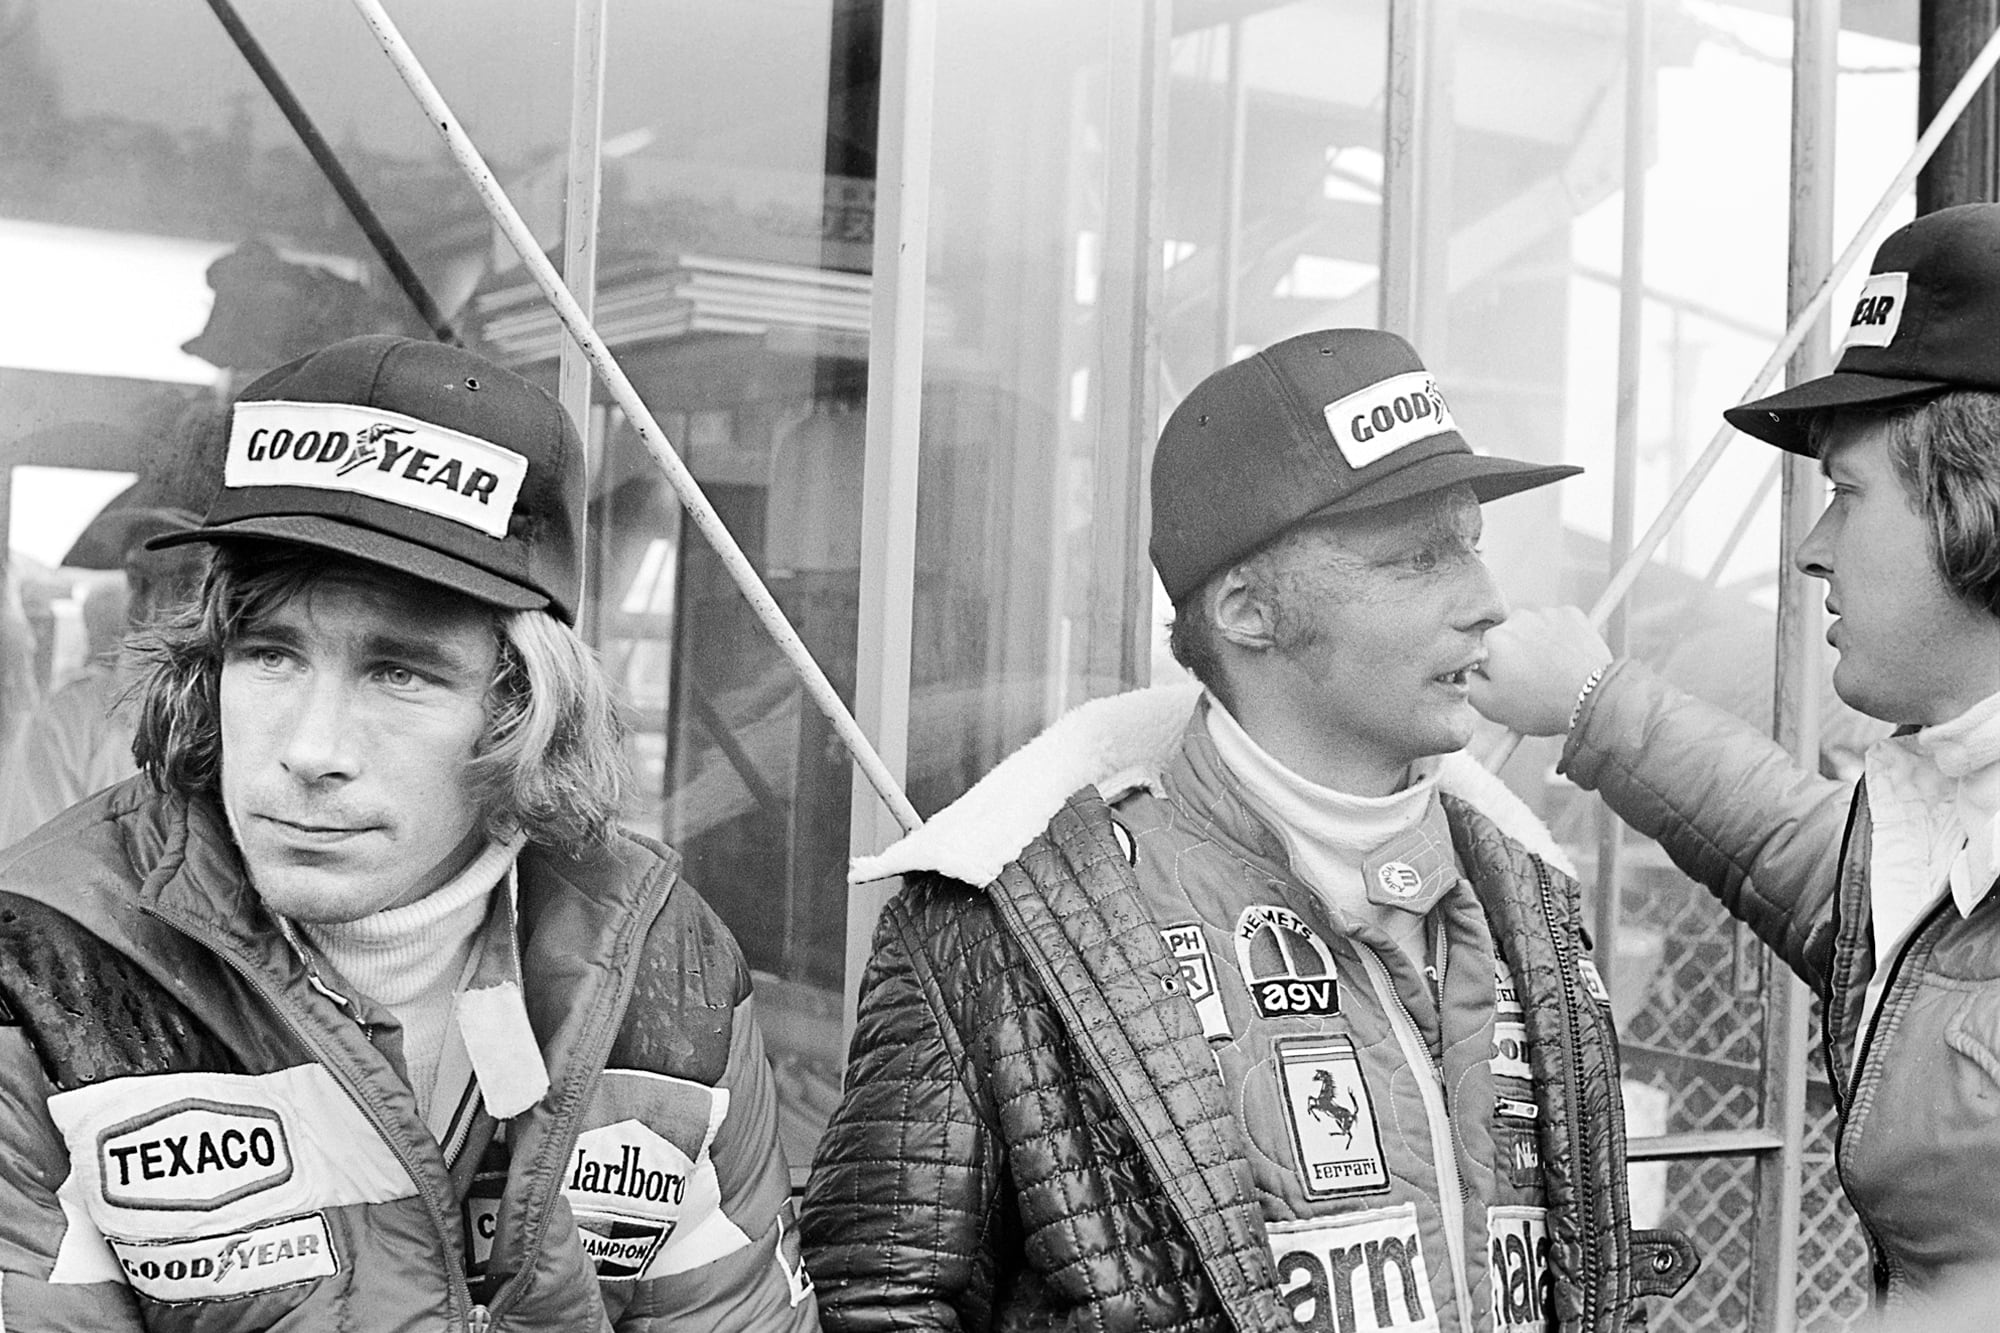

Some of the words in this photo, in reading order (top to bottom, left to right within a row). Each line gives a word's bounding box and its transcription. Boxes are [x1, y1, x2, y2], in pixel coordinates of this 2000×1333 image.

[1351, 392, 1431, 442] GOOD
[1241, 910, 1313, 940] HEMETS
[1262, 982, 1330, 1012] agv
[109, 1127, 275, 1186] TEXACO
[1312, 1158, 1378, 1179] Ferrari
